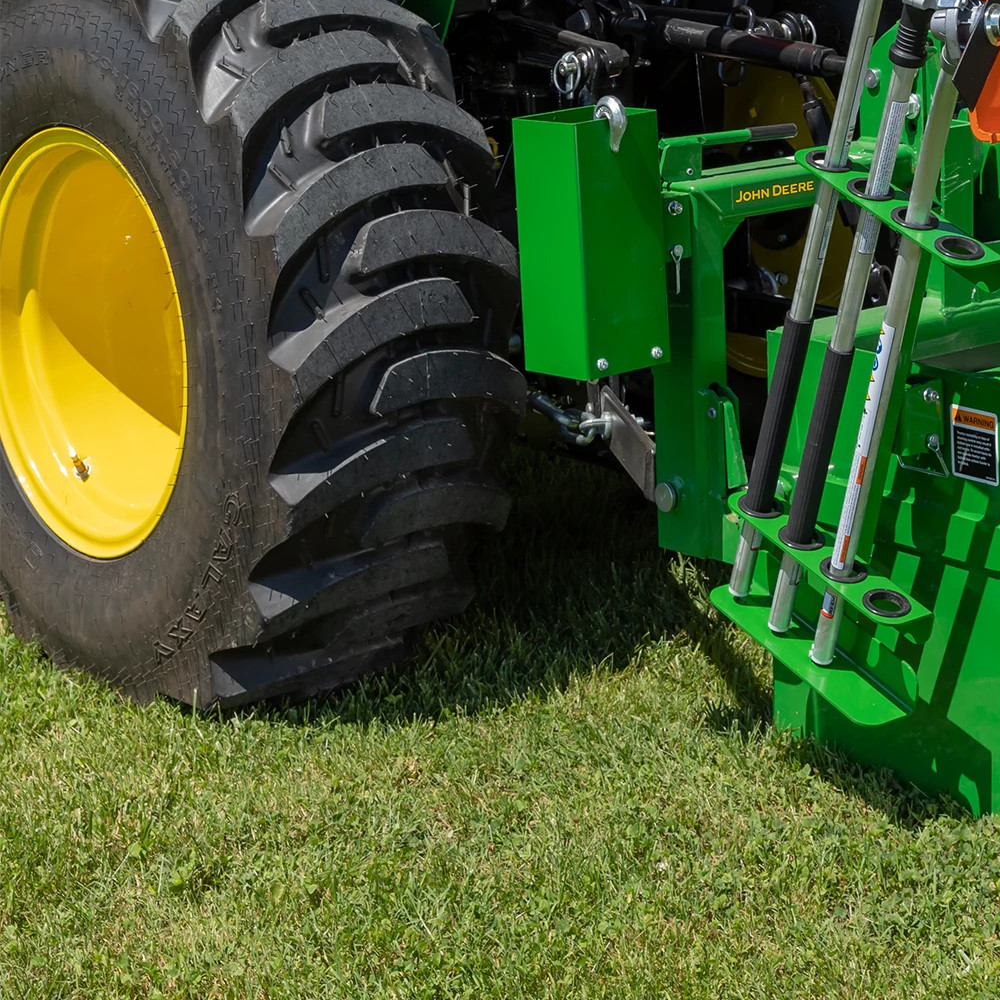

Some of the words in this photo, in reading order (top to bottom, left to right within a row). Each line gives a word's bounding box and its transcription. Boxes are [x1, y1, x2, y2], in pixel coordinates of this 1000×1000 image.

[736, 187, 770, 203] JOHN
[772, 180, 815, 197] DEERE
[963, 416, 995, 428] WARNING
[153, 491, 242, 666] GALAXY
